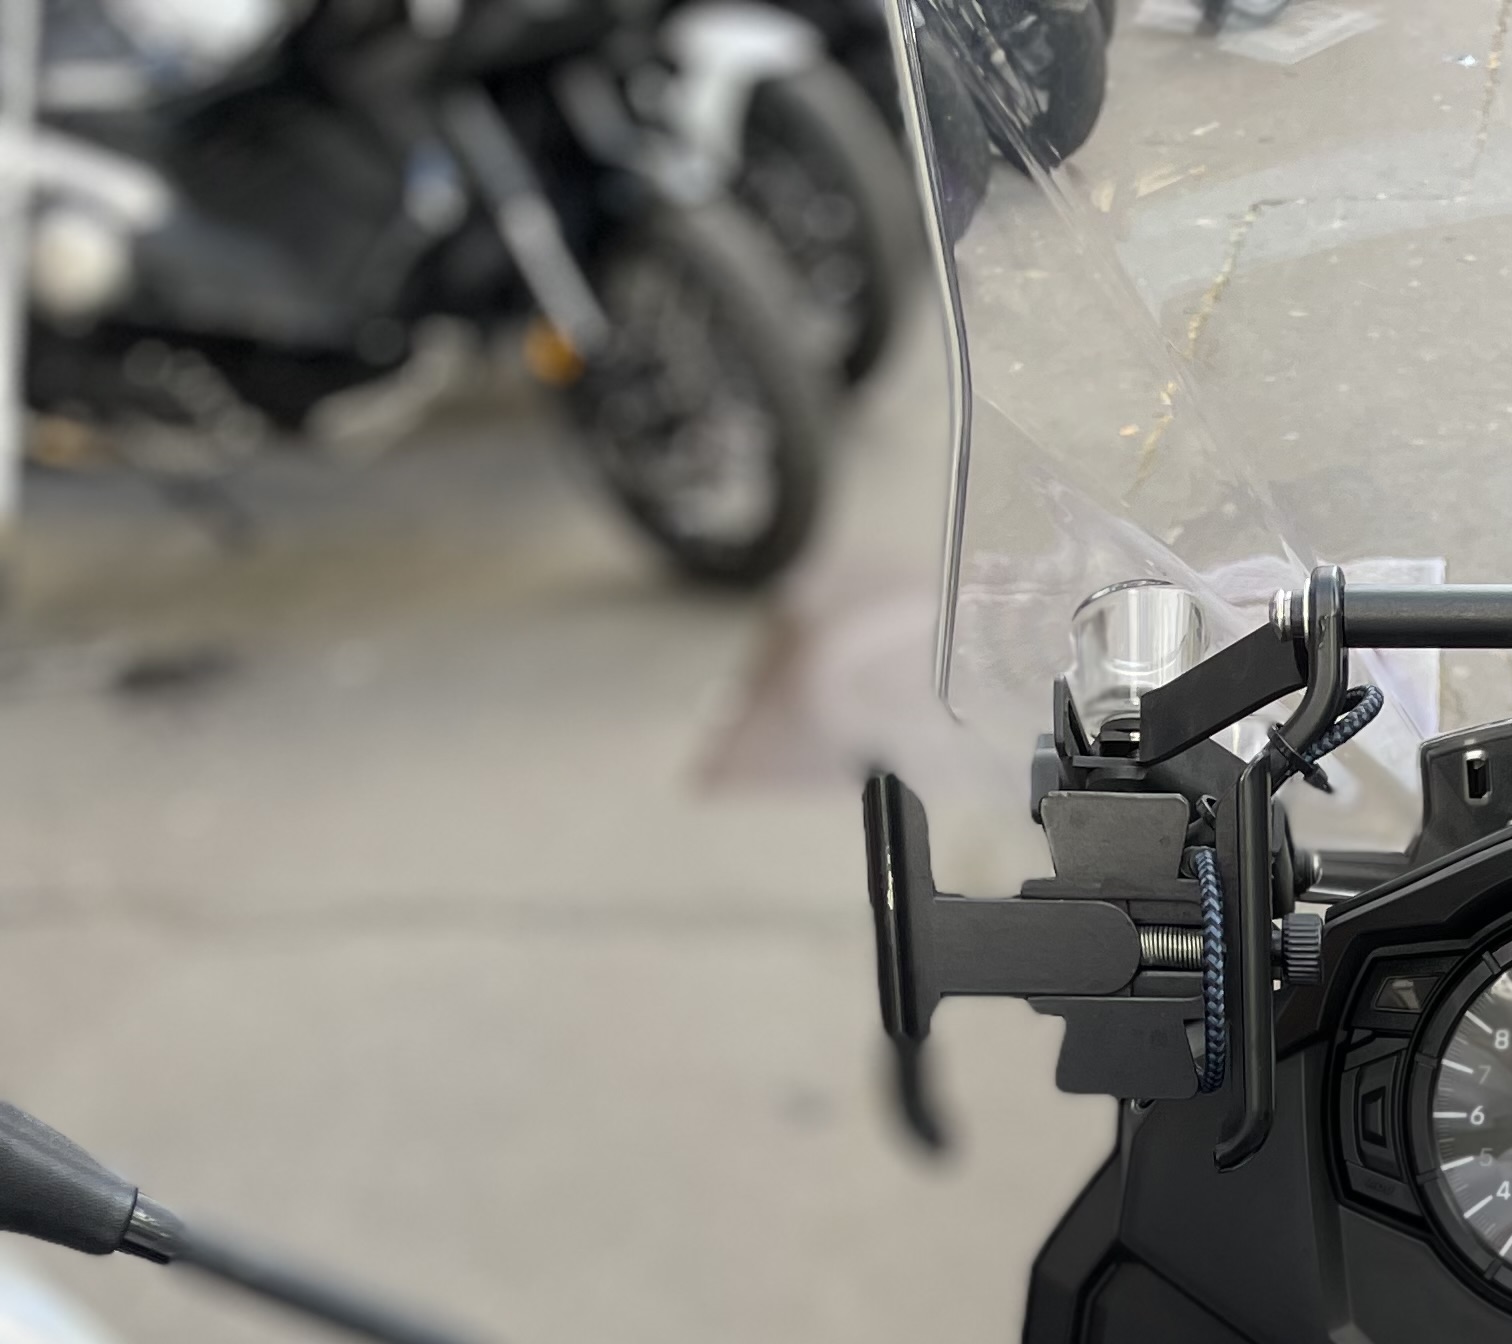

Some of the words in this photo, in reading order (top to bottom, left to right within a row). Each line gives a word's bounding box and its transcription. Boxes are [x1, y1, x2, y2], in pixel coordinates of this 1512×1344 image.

[1494, 1029, 1510, 1050] 8
[1479, 1065, 1492, 1085] 7
[1470, 1105, 1485, 1126] 6
[1479, 1148, 1493, 1167] 5
[1496, 1180, 1511, 1201] 4
